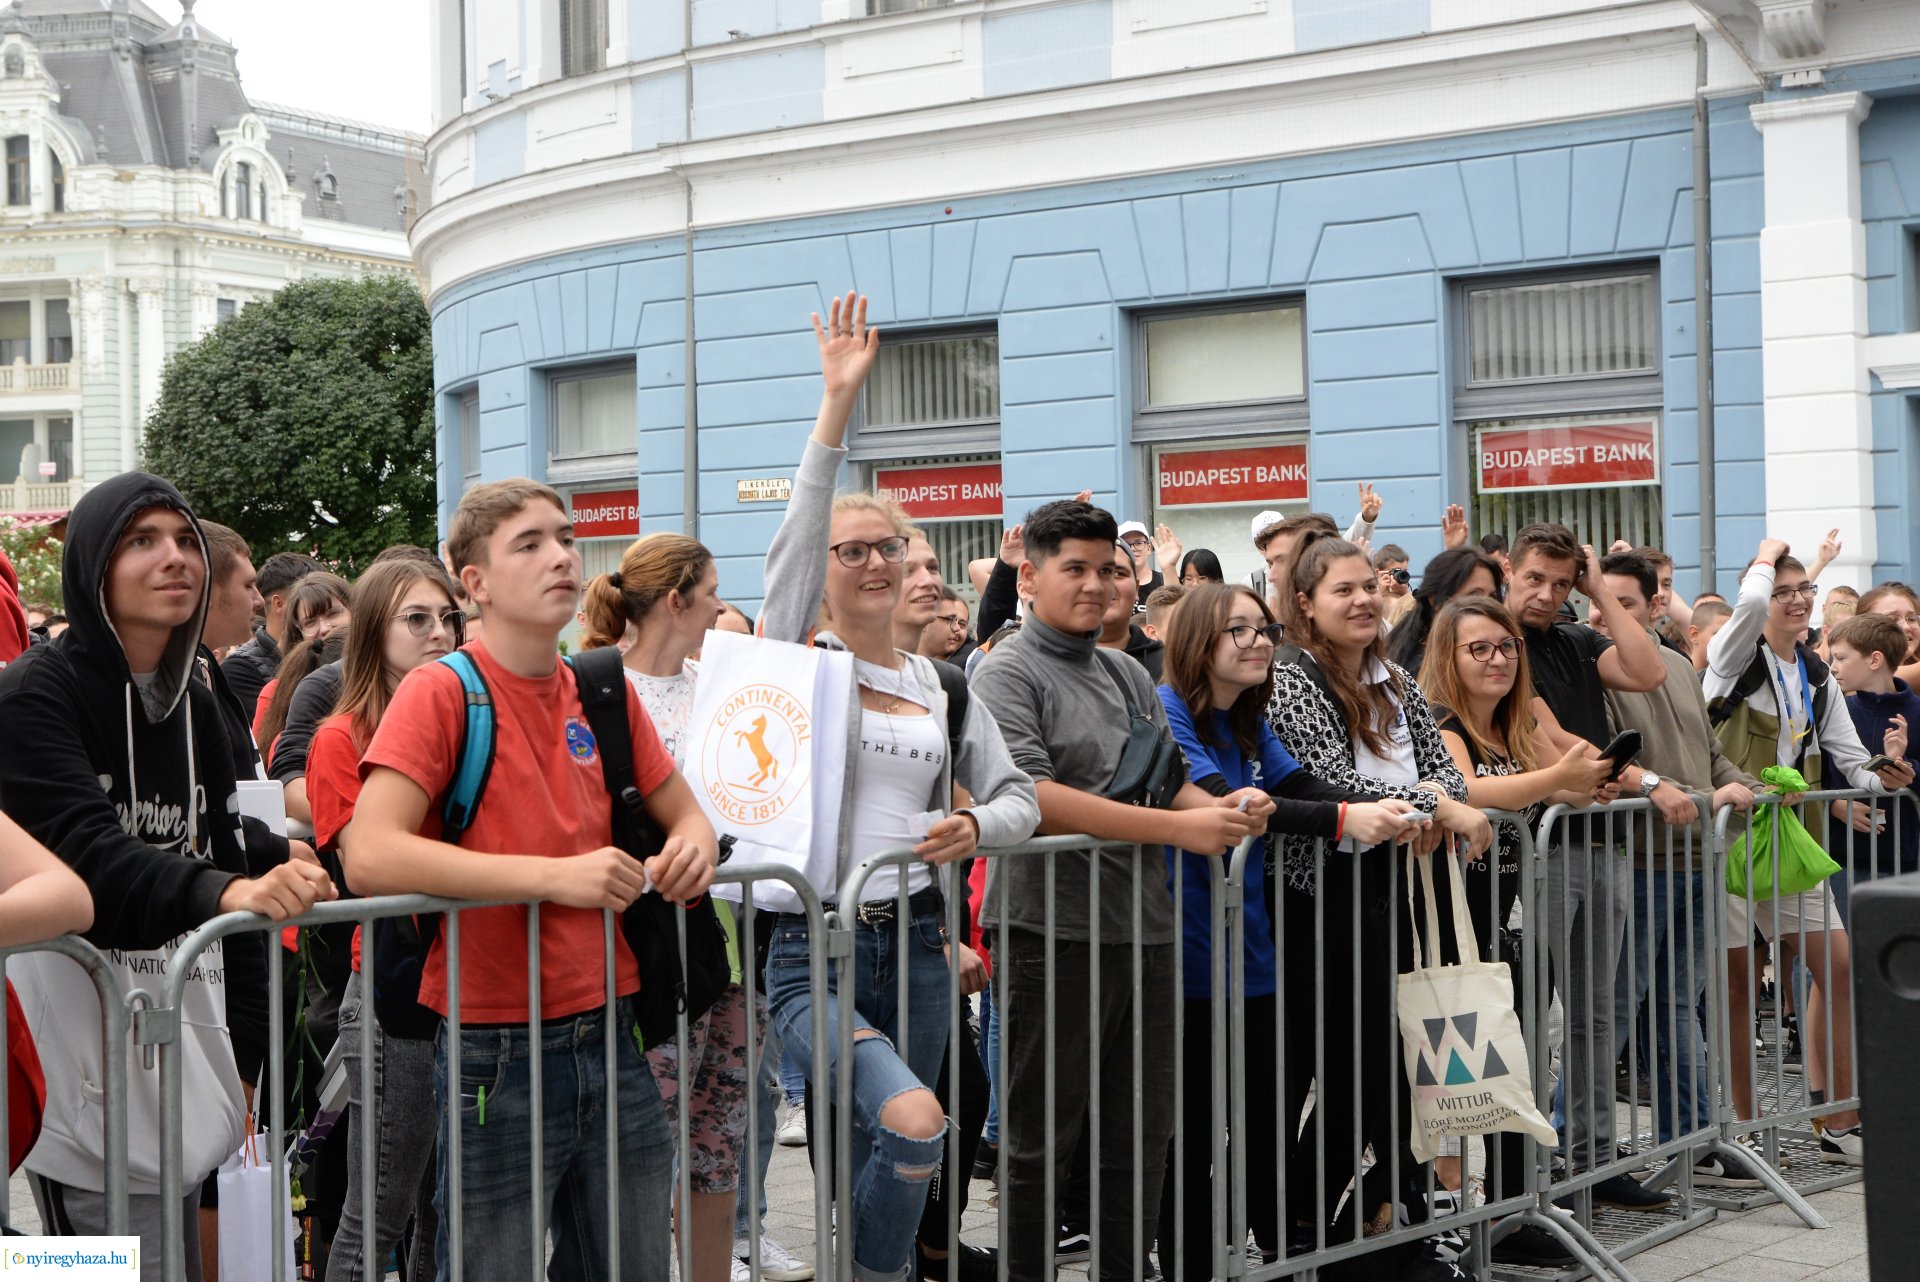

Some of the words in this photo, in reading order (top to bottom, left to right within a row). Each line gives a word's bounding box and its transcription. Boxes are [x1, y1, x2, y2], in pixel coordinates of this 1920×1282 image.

[1482, 446, 1588, 470] BUDAPEST
[1593, 442, 1653, 463] BANK
[1160, 466, 1252, 488] BUDAPEST
[1256, 464, 1307, 483] BANK
[761, 489, 777, 498] LAJOS
[962, 482, 1004, 499] BANK
[572, 506, 626, 523] BUDAPEST
[628, 505, 640, 520] BA
[717, 688, 812, 746] CONTINENTAL
[861, 740, 899, 755] THE
[910, 748, 942, 765] BES
[709, 781, 746, 821] SINCE
[752, 796, 785, 821] 1871
[1436, 1091, 1495, 1111] WITTUR
